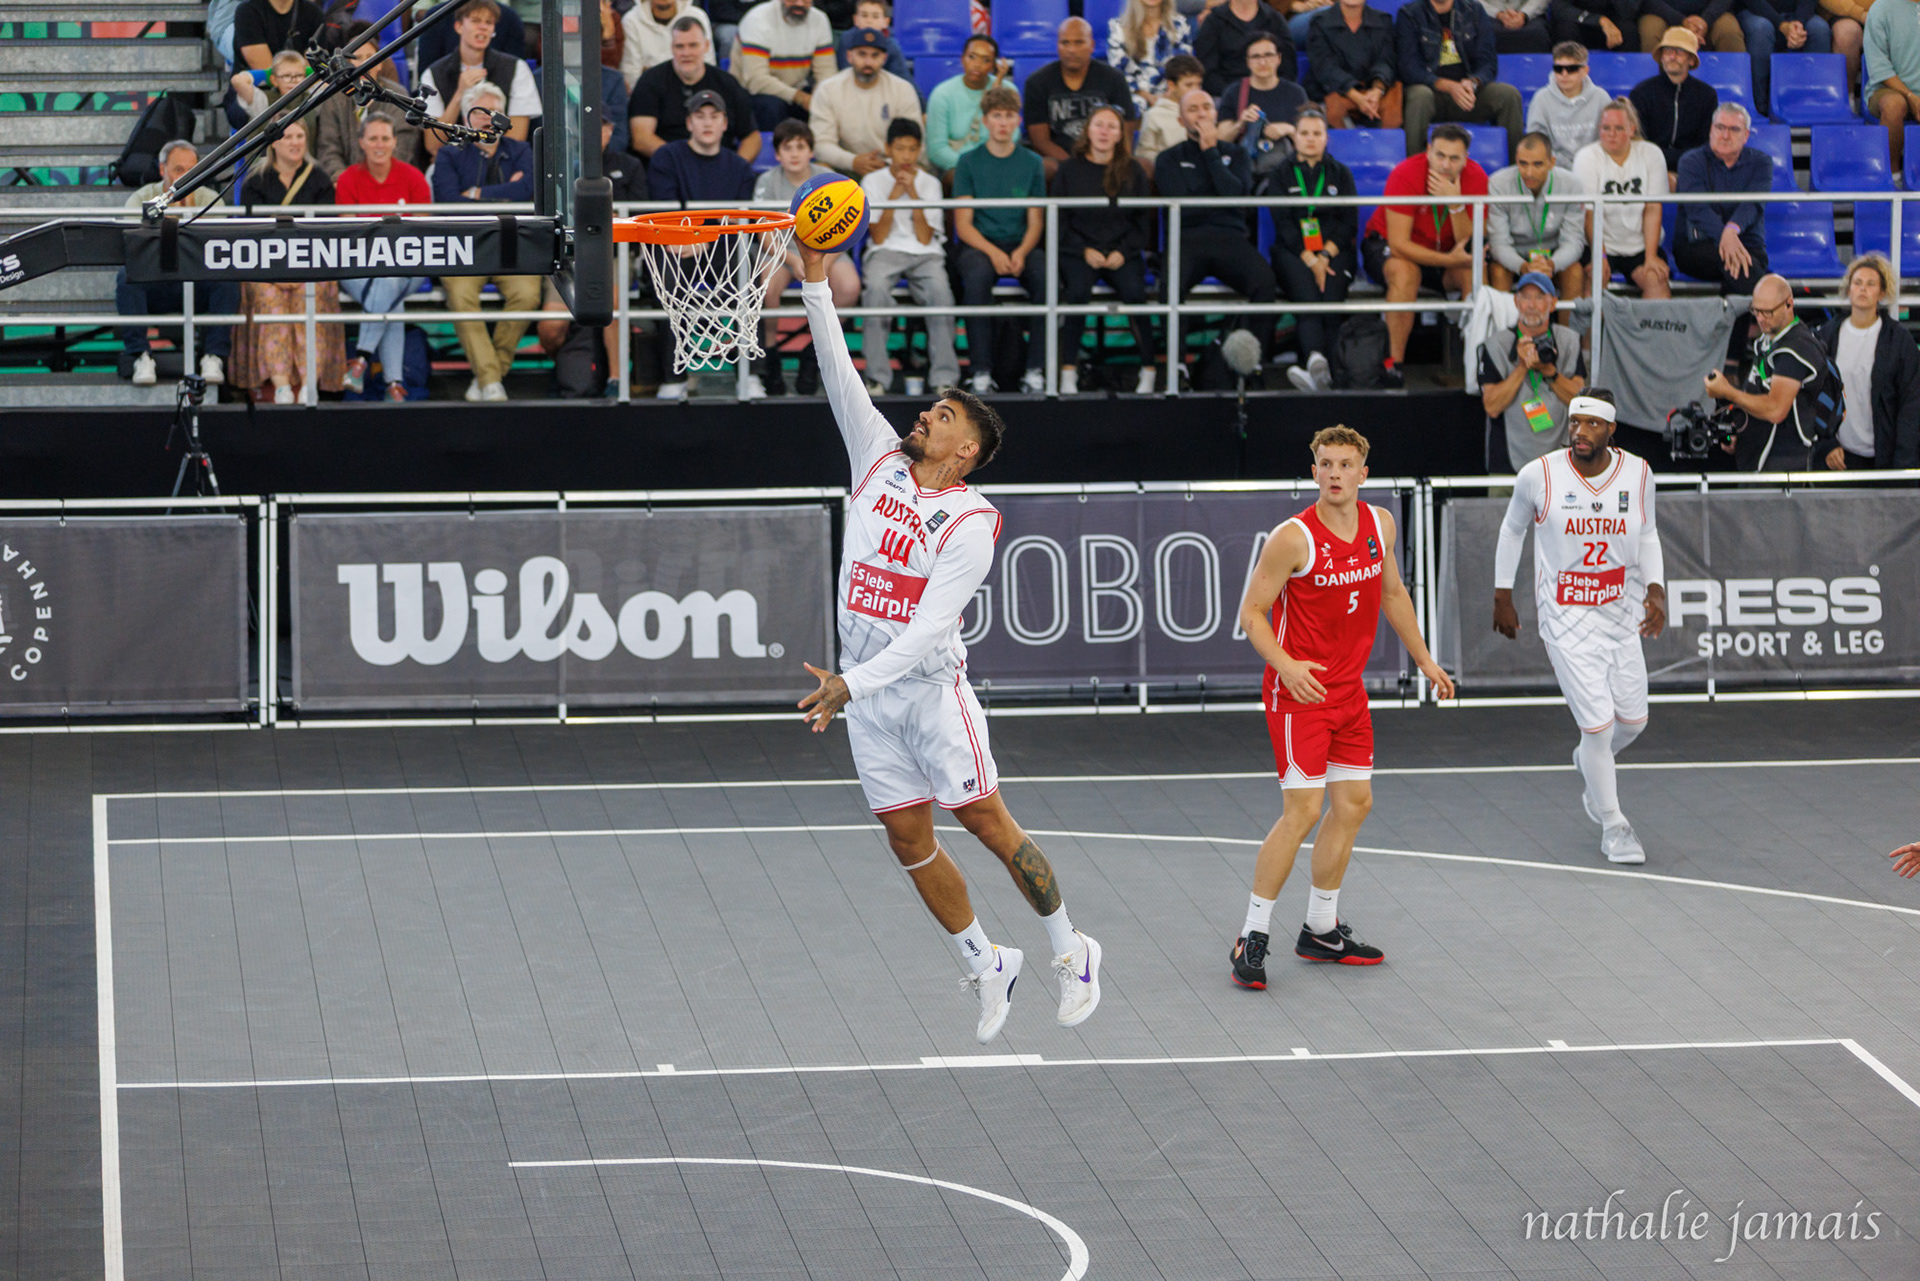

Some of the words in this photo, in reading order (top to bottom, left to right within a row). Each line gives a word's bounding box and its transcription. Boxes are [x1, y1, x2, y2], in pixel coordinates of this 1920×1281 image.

[814, 205, 861, 245] Wilson
[204, 235, 474, 270] COPENHAGEN
[1639, 317, 1688, 333] austria
[1564, 517, 1627, 536] AUSTRIA
[878, 528, 915, 567] 44
[1583, 541, 1609, 567] 22
[852, 563, 866, 581] Es
[865, 572, 894, 592] lebe
[1314, 560, 1383, 587] DANMARK
[1559, 573, 1572, 584] Es
[1573, 576, 1600, 588] lebe
[850, 585, 919, 618] Fairpla
[1347, 590, 1360, 615] 5
[1563, 583, 1624, 606] Fairplay
[1666, 576, 1883, 627] RESS
[2, 543, 52, 681] COPENHA
[338, 555, 767, 666] Wilson
[1697, 632, 1791, 658] SPORT
[1802, 630, 1823, 656] &
[1833, 629, 1885, 655] LEG
